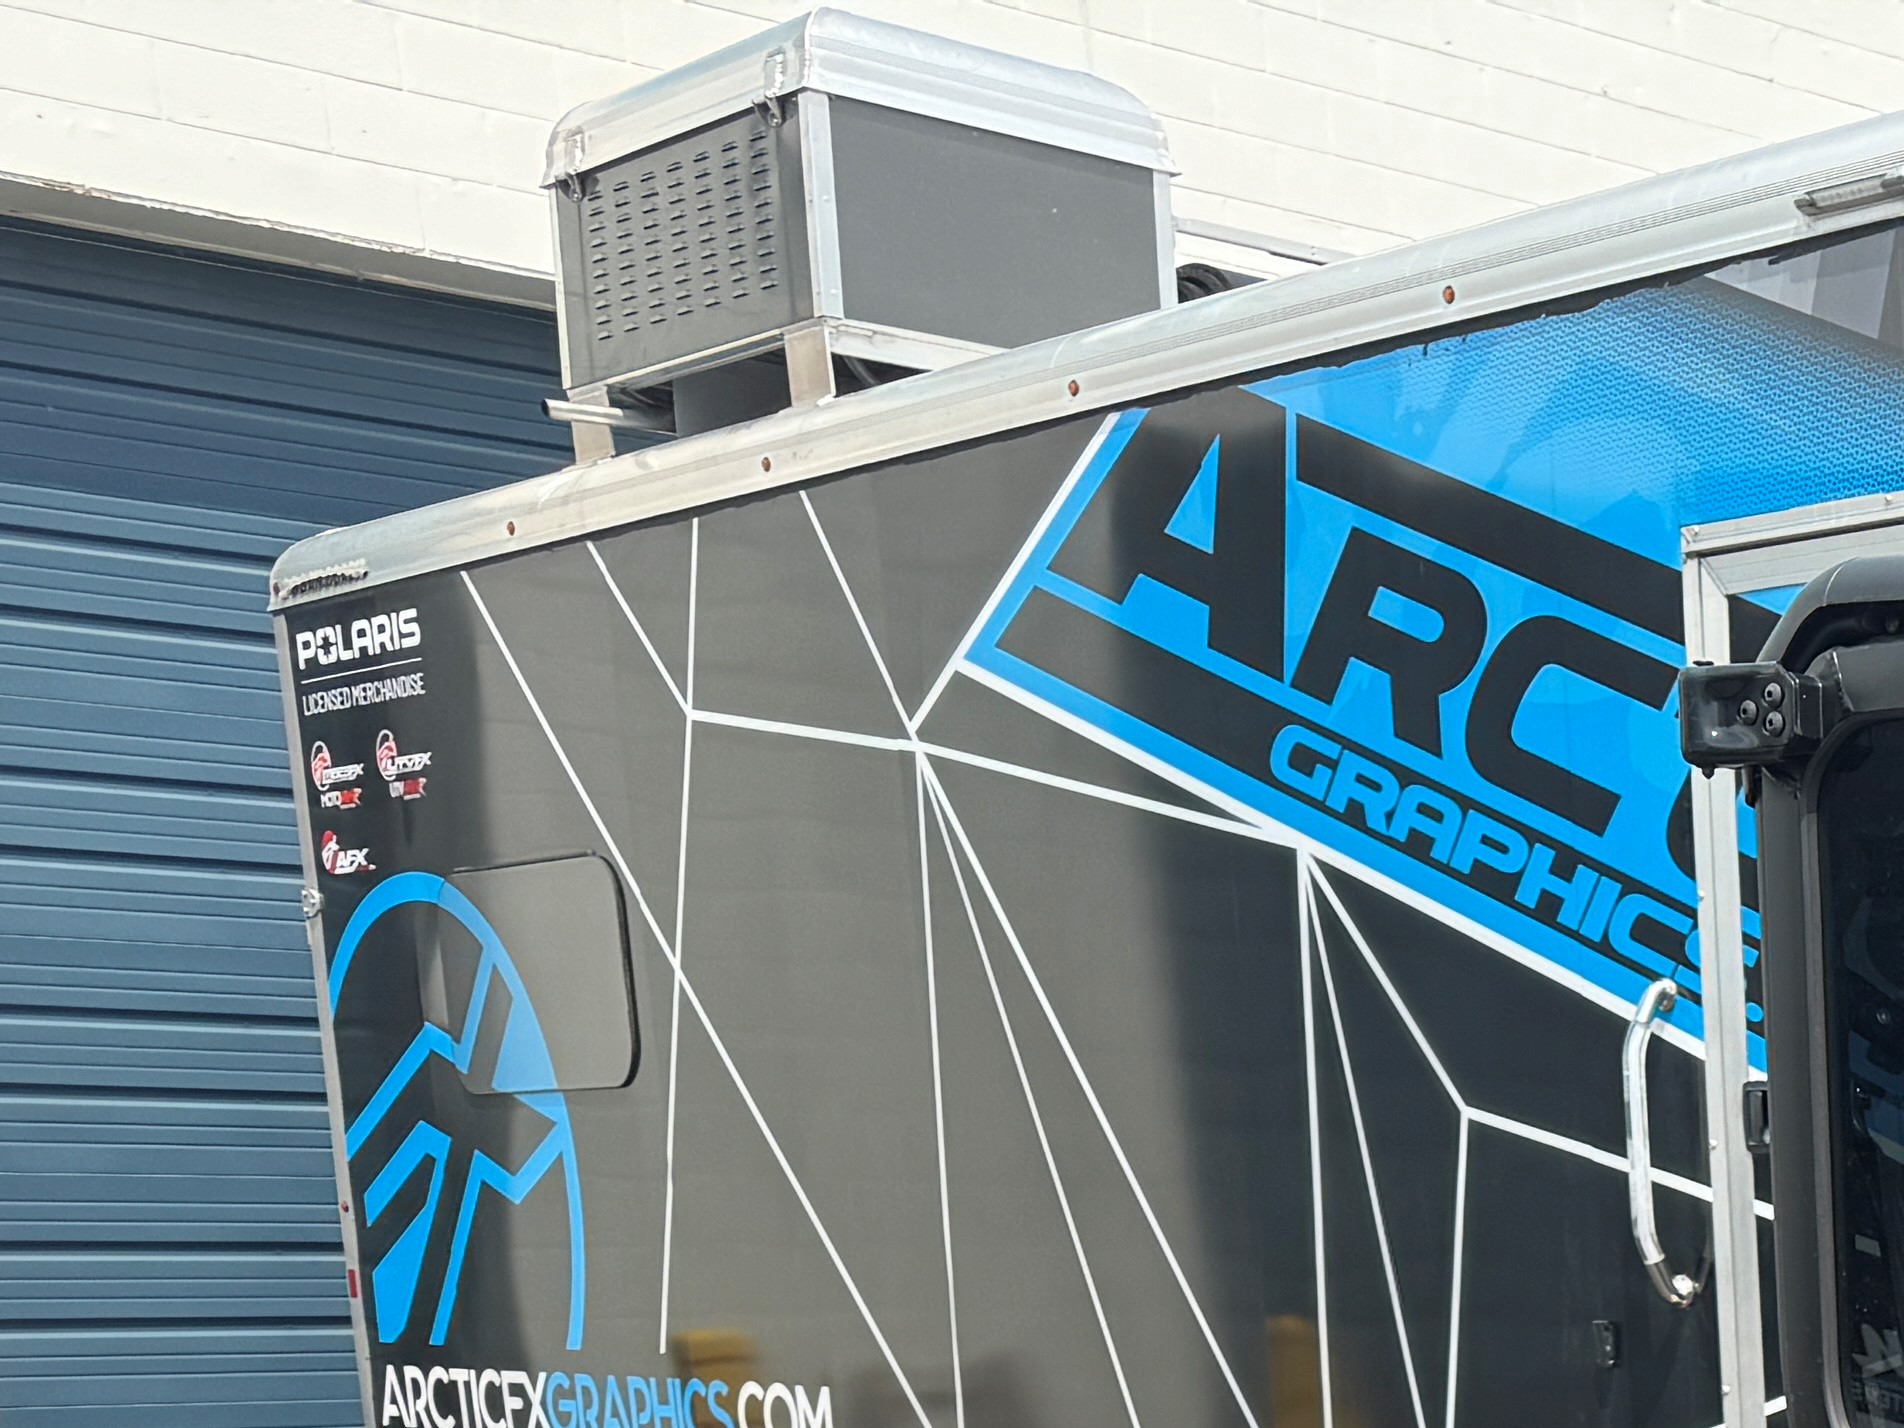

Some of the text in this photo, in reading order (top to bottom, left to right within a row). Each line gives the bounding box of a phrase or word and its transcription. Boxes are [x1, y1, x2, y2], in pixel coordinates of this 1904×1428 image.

[295, 607, 421, 670] POLARIS
[302, 672, 426, 716] LICENSED MERCHANDISE
